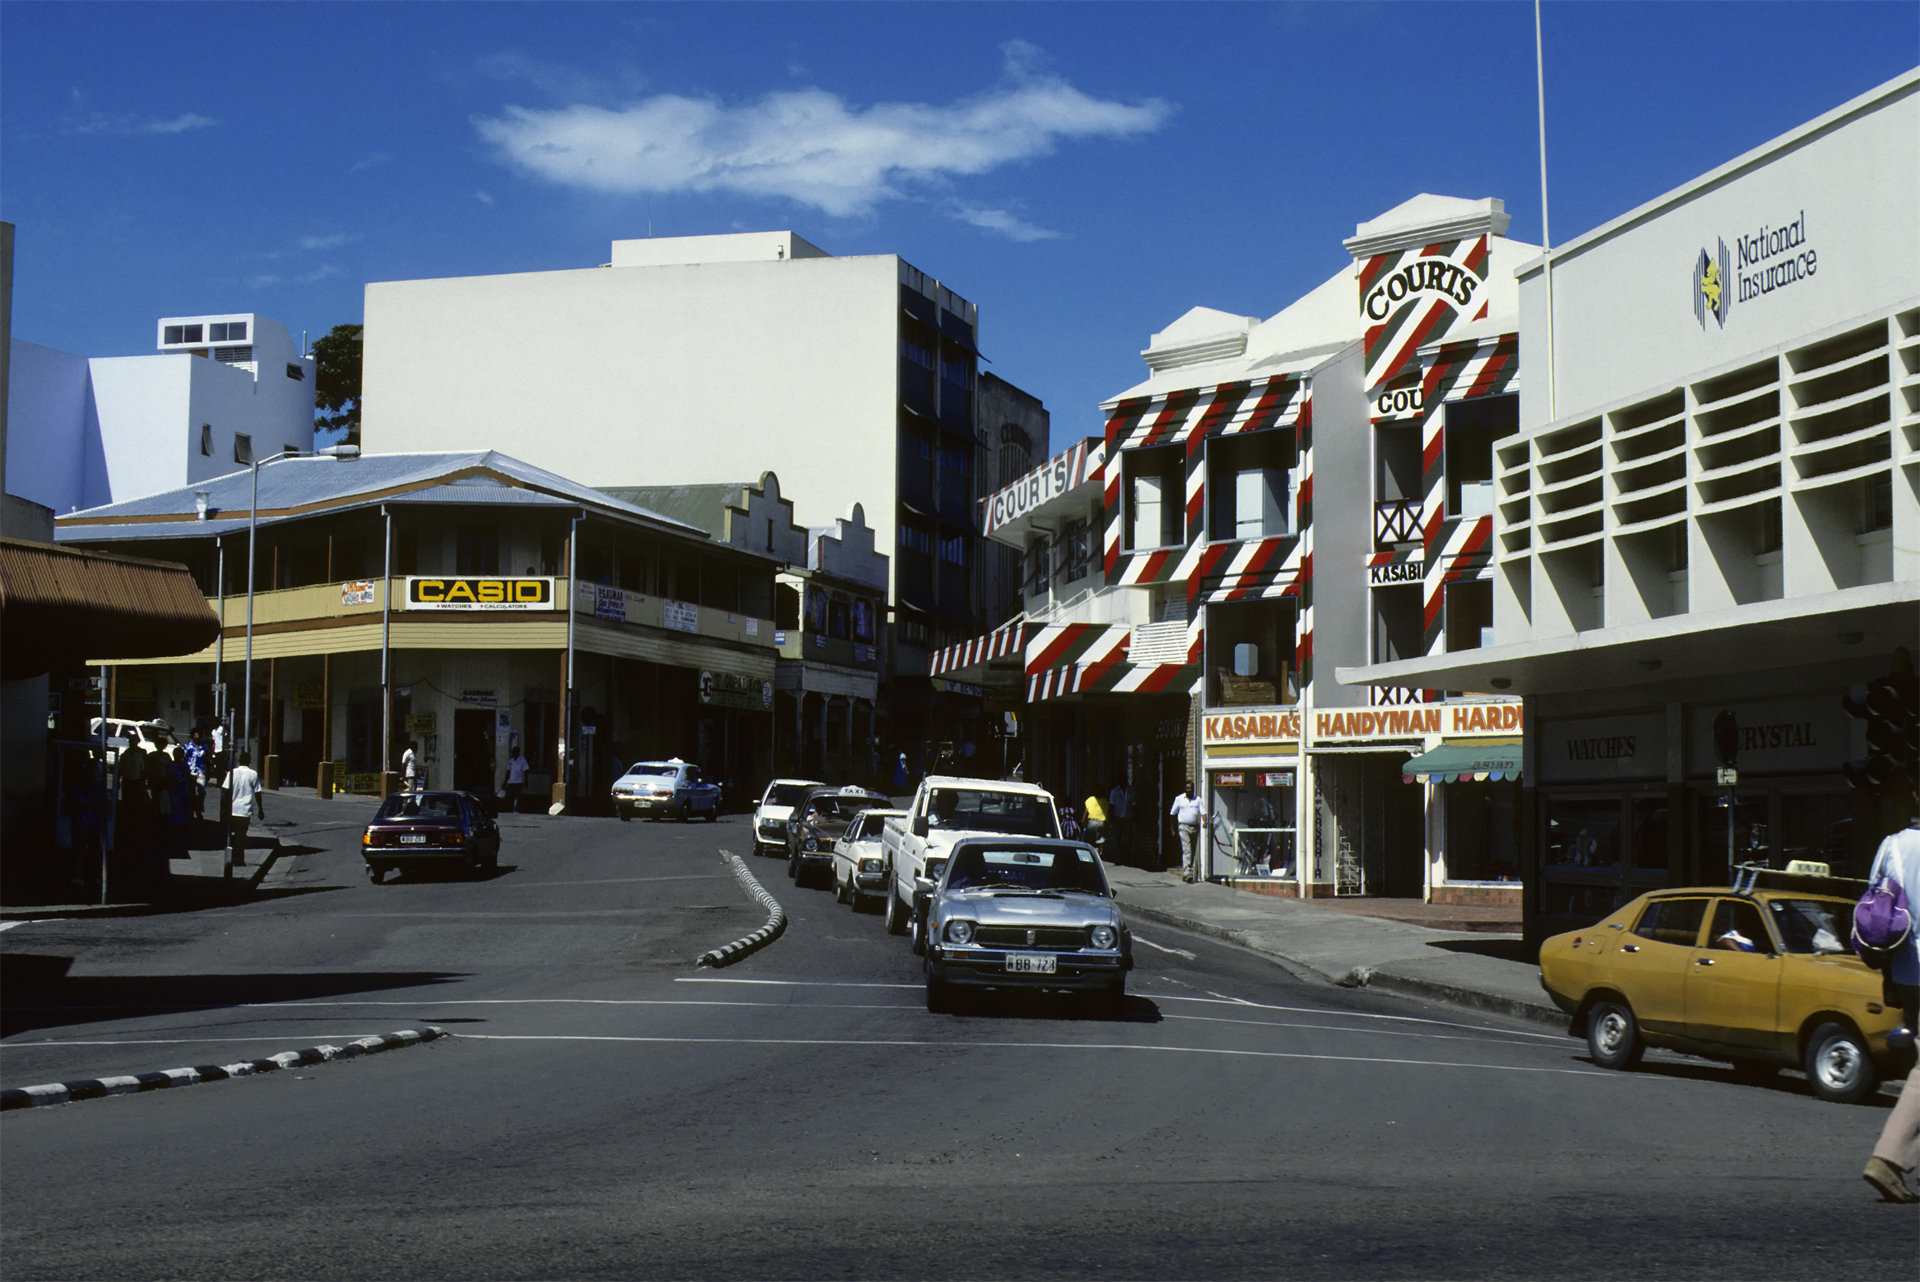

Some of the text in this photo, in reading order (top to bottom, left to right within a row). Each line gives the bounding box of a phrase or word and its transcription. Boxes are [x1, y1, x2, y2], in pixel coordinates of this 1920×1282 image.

[1737, 209, 1806, 270] National
[1366, 260, 1477, 320] COURTS
[1738, 249, 1817, 304] Insurance
[995, 460, 1066, 525] COURTS
[418, 580, 541, 602] CASIO
[1205, 711, 1301, 739] KASABIA'S
[1316, 709, 1441, 737] HANDYMAN
[1567, 722, 1817, 761] WATCHES CRYSTAL
[1471, 759, 1515, 770] asian
[1797, 863, 1828, 874] TAXI
